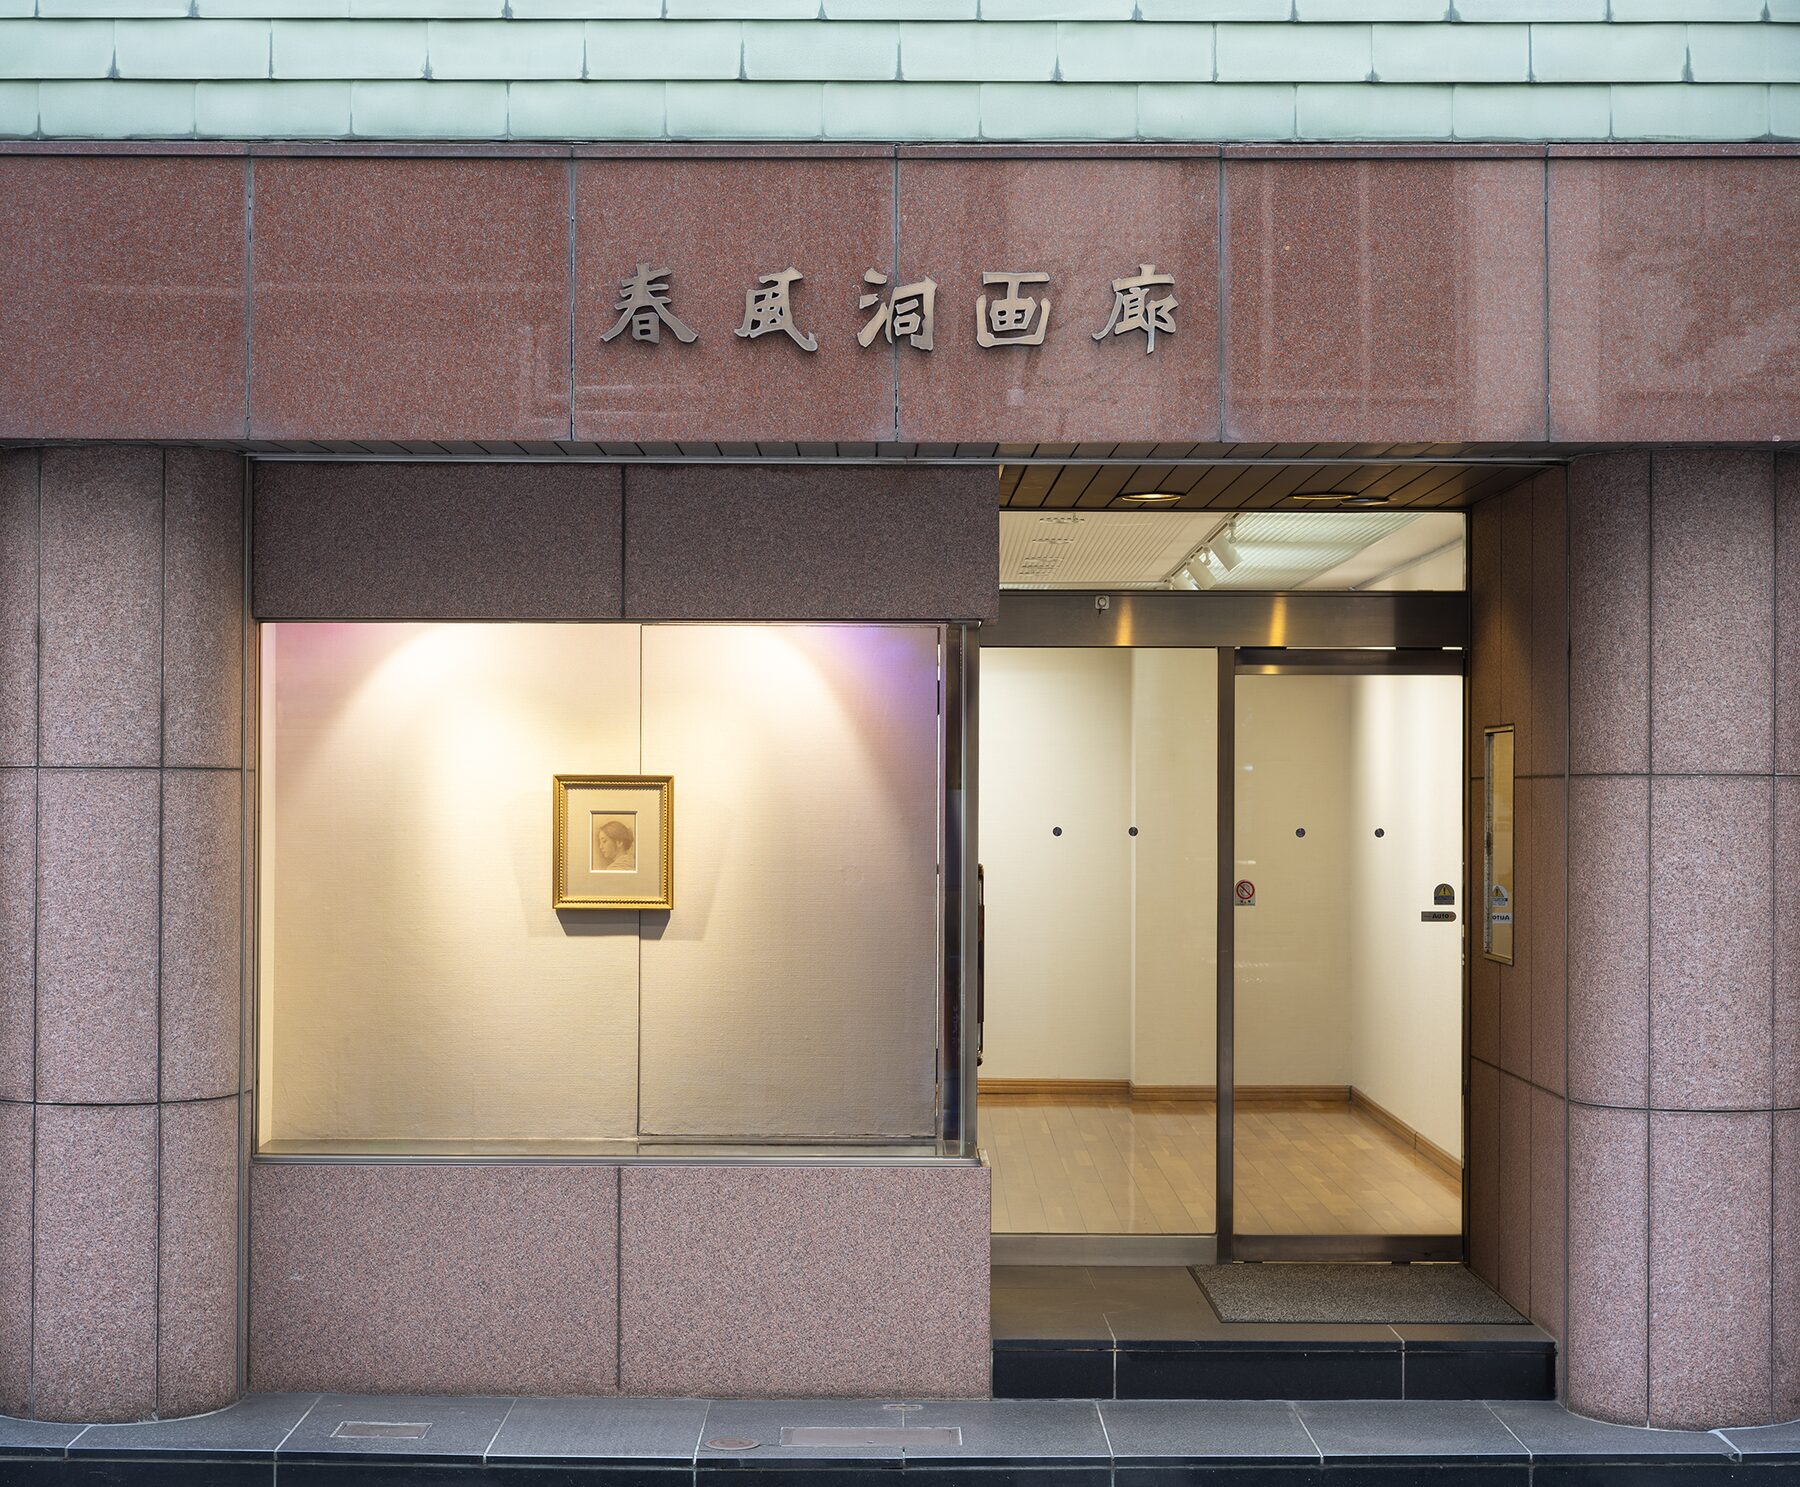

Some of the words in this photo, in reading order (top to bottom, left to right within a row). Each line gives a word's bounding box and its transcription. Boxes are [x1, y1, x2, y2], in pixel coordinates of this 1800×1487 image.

[601, 262, 1179, 354] 春風洞画廊
